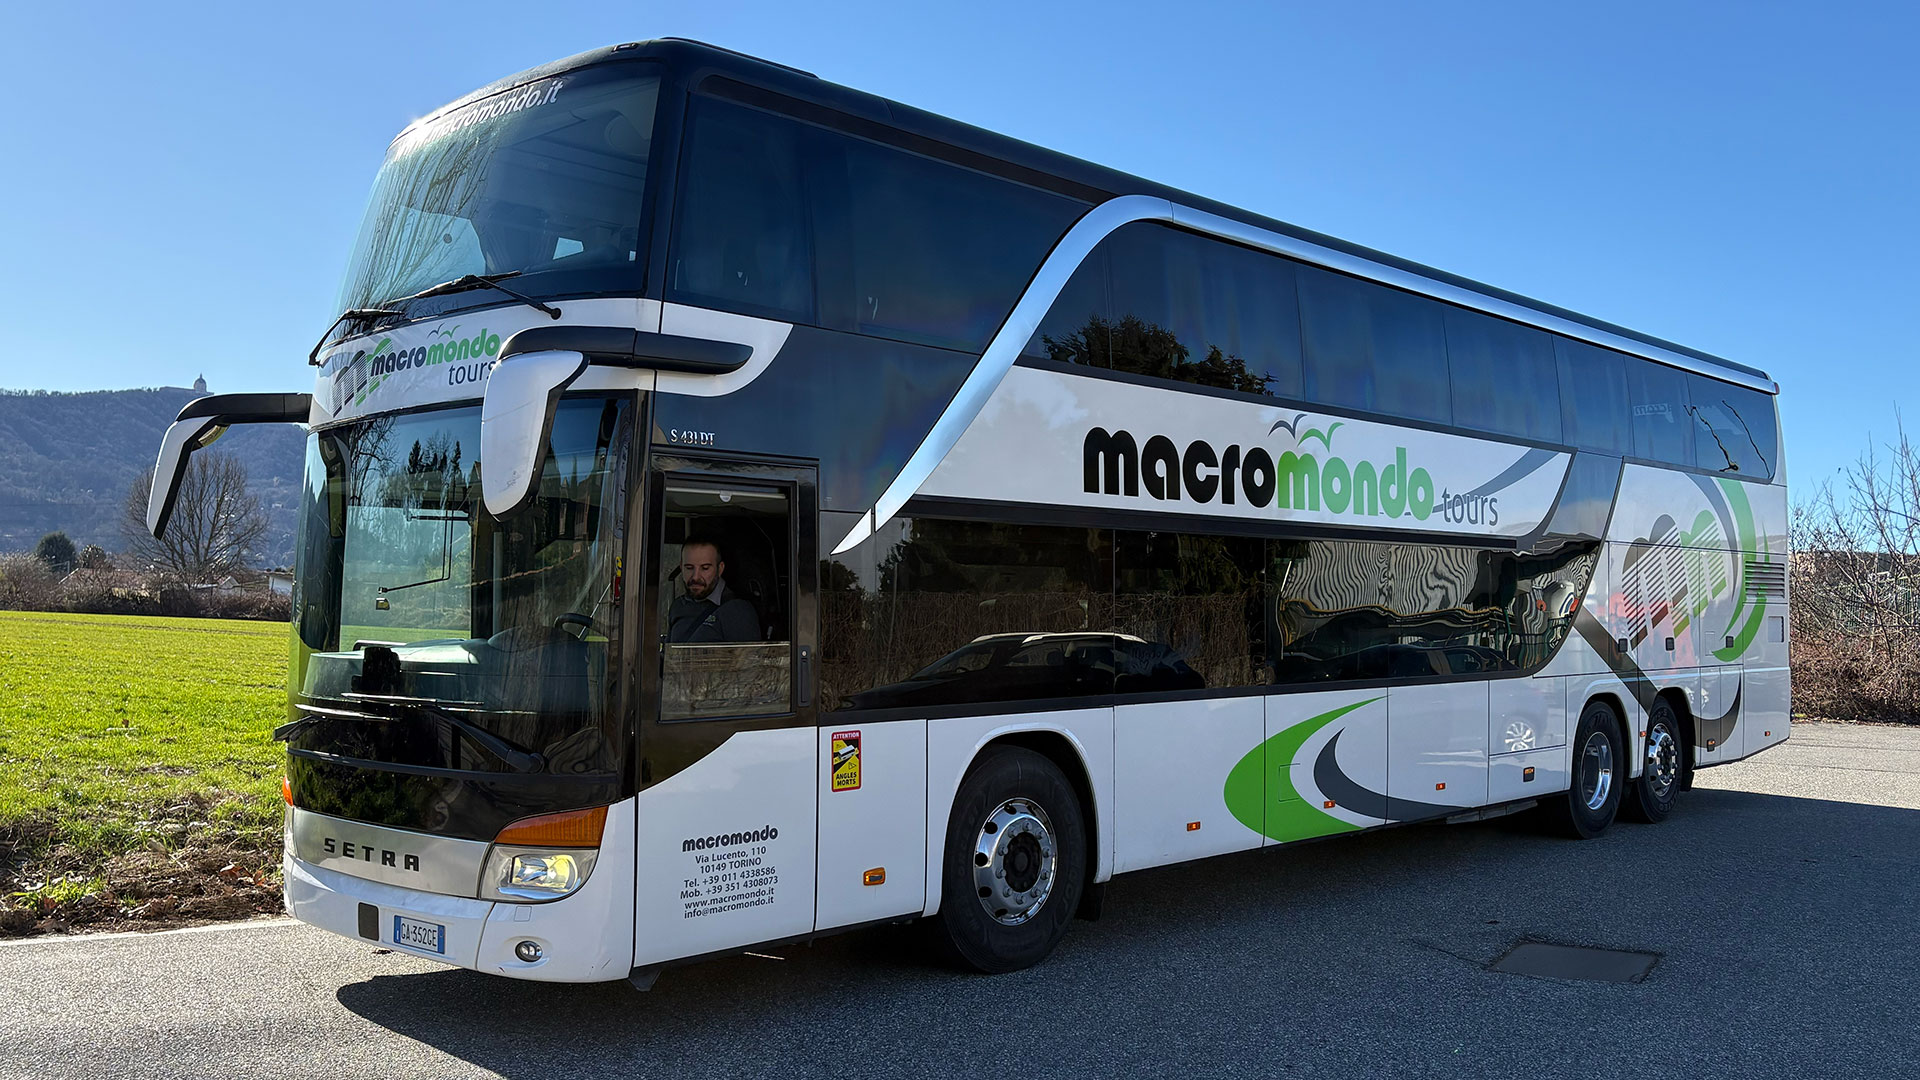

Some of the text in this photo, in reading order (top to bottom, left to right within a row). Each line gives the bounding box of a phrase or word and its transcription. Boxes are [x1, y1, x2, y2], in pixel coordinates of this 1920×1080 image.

[371, 328, 500, 377] macromondo
[670, 429, 715, 445] S 431 DT
[1083, 426, 1499, 526] macromondo tours
[836, 772, 857, 780] ANGLES
[682, 825, 778, 852] macromondo
[324, 837, 419, 872] SETRA
[695, 846, 767, 864] Via Lucento, 110
[700, 857, 761, 874] 10149 TORINO
[680, 876, 778, 899] Mob. +39 351 4308073
[684, 866, 776, 888] Tel. +39 011 4338586
[684, 887, 775, 909] www.macromondo.it
[684, 896, 774, 919] info@macromondo.it
